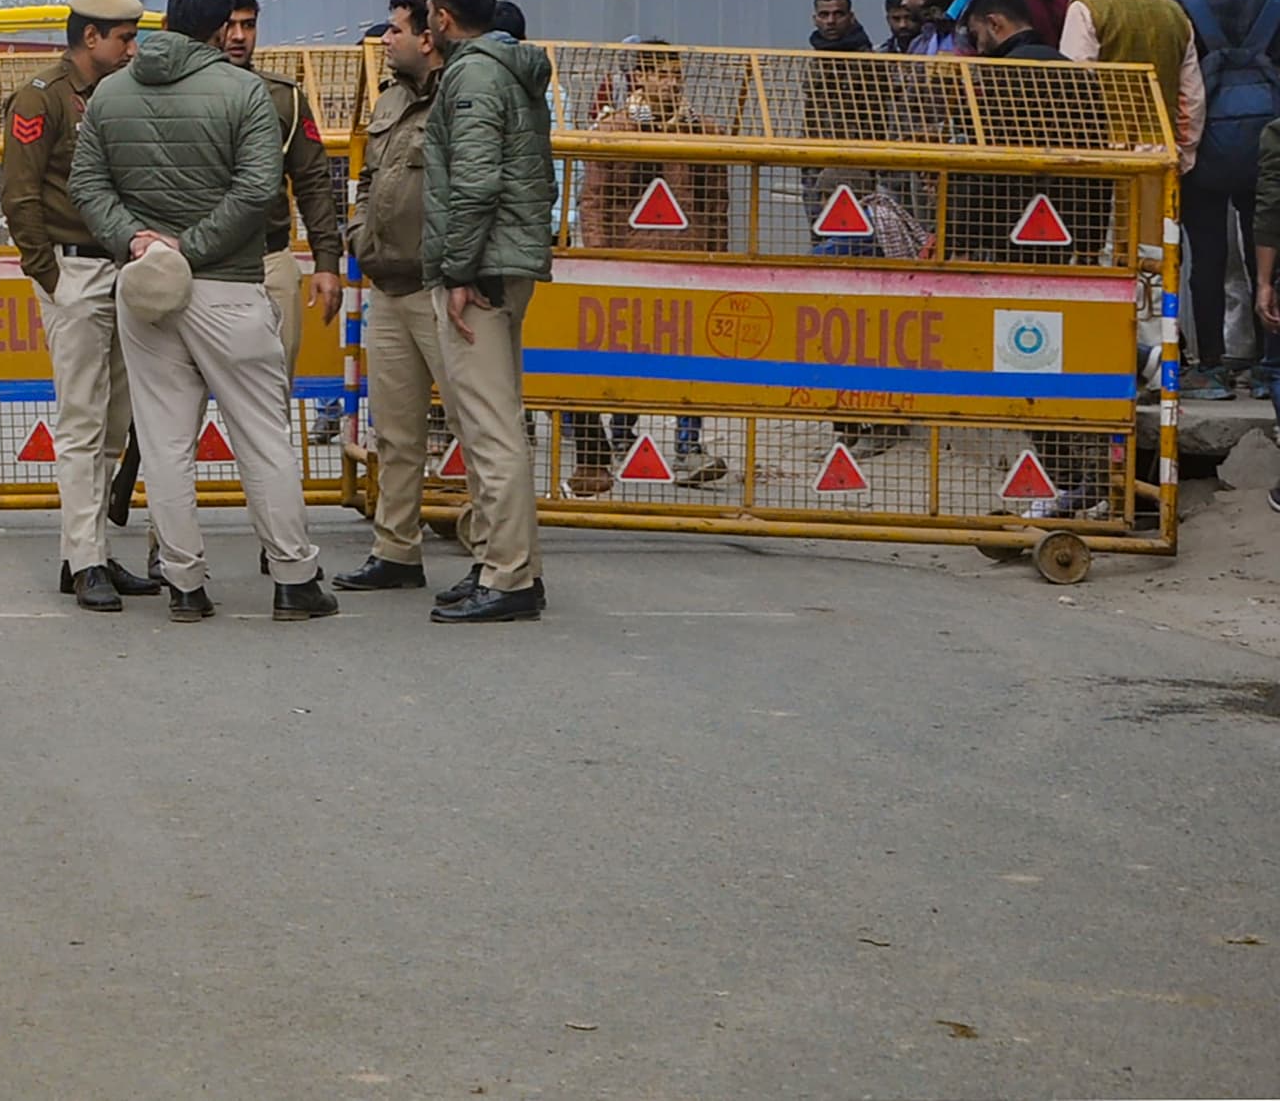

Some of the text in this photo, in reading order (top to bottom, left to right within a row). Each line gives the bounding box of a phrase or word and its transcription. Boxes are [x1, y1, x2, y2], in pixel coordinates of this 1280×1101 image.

[577, 296, 945, 371] DELHI POLICE
[711, 318, 734, 338] 32
